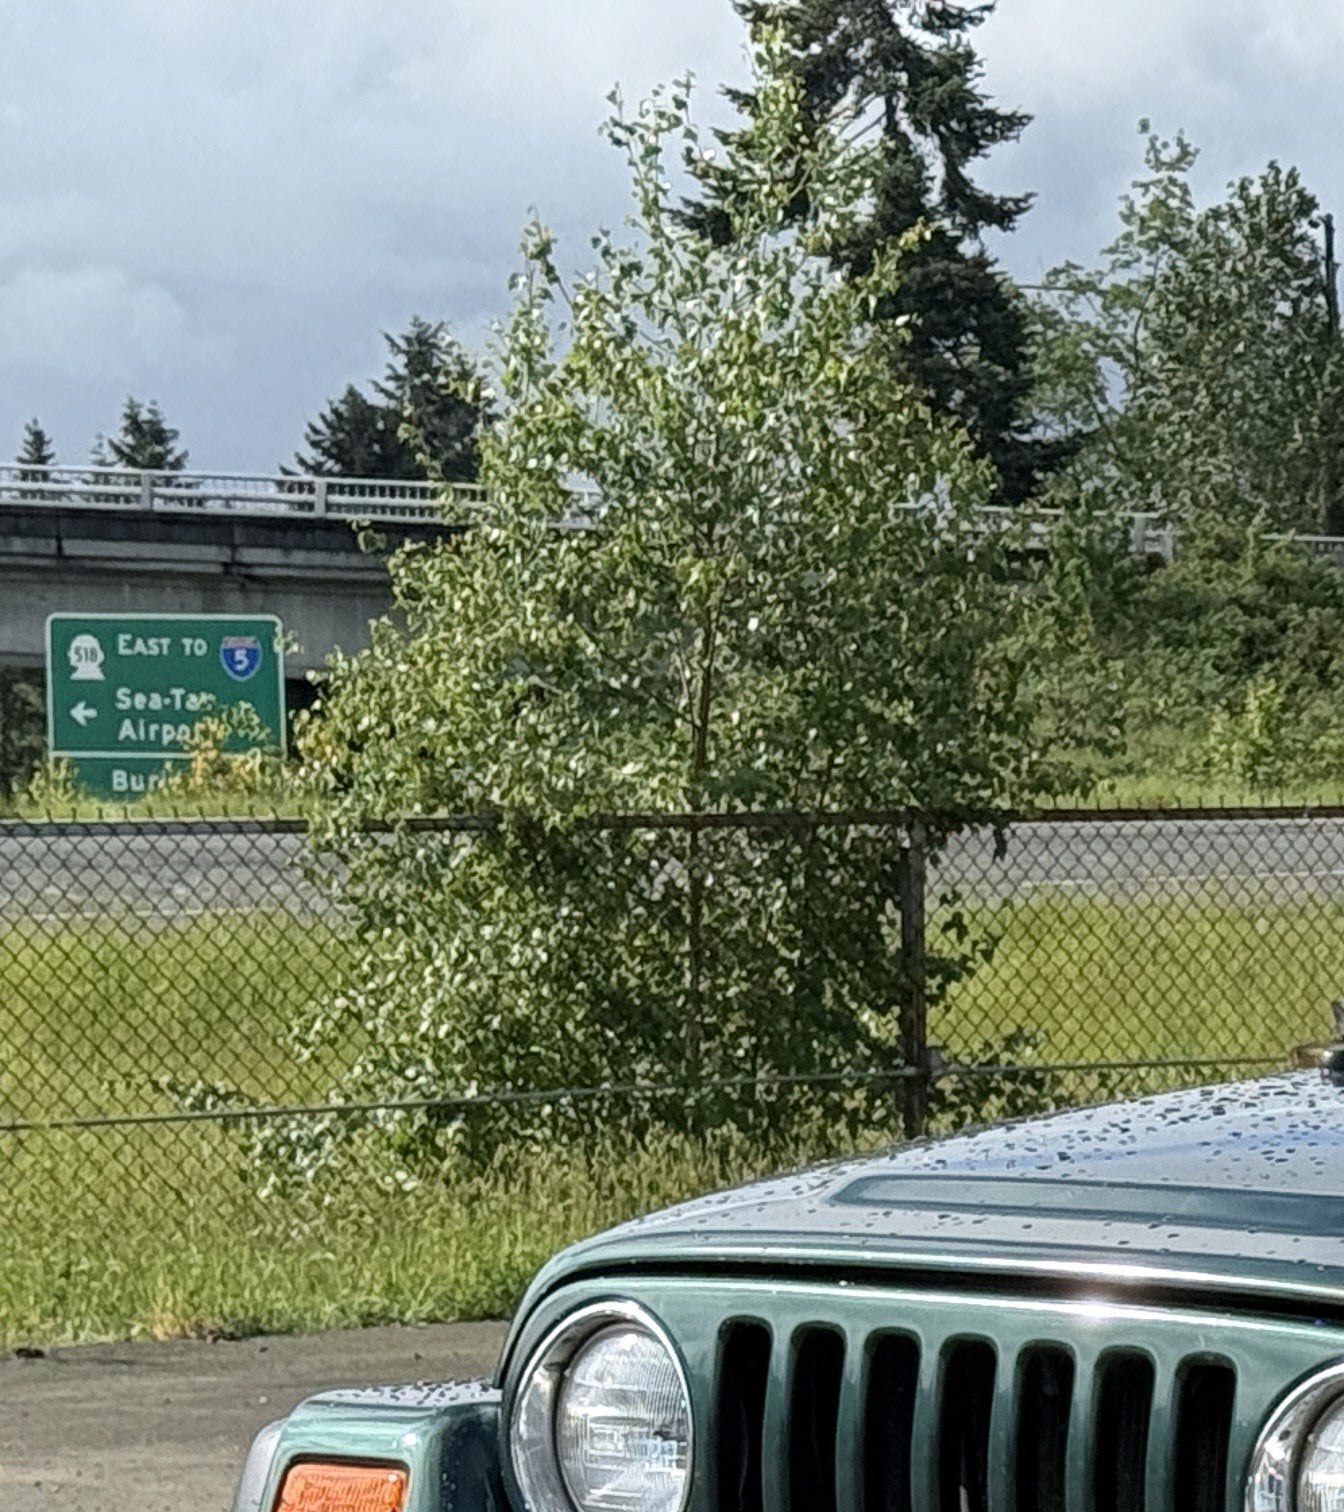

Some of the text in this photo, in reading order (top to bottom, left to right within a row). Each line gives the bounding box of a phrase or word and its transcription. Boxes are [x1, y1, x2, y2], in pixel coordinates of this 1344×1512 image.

[74, 645, 98, 663] 518
[234, 648, 249, 671] 5
[115, 687, 214, 711] Sea-Ta
